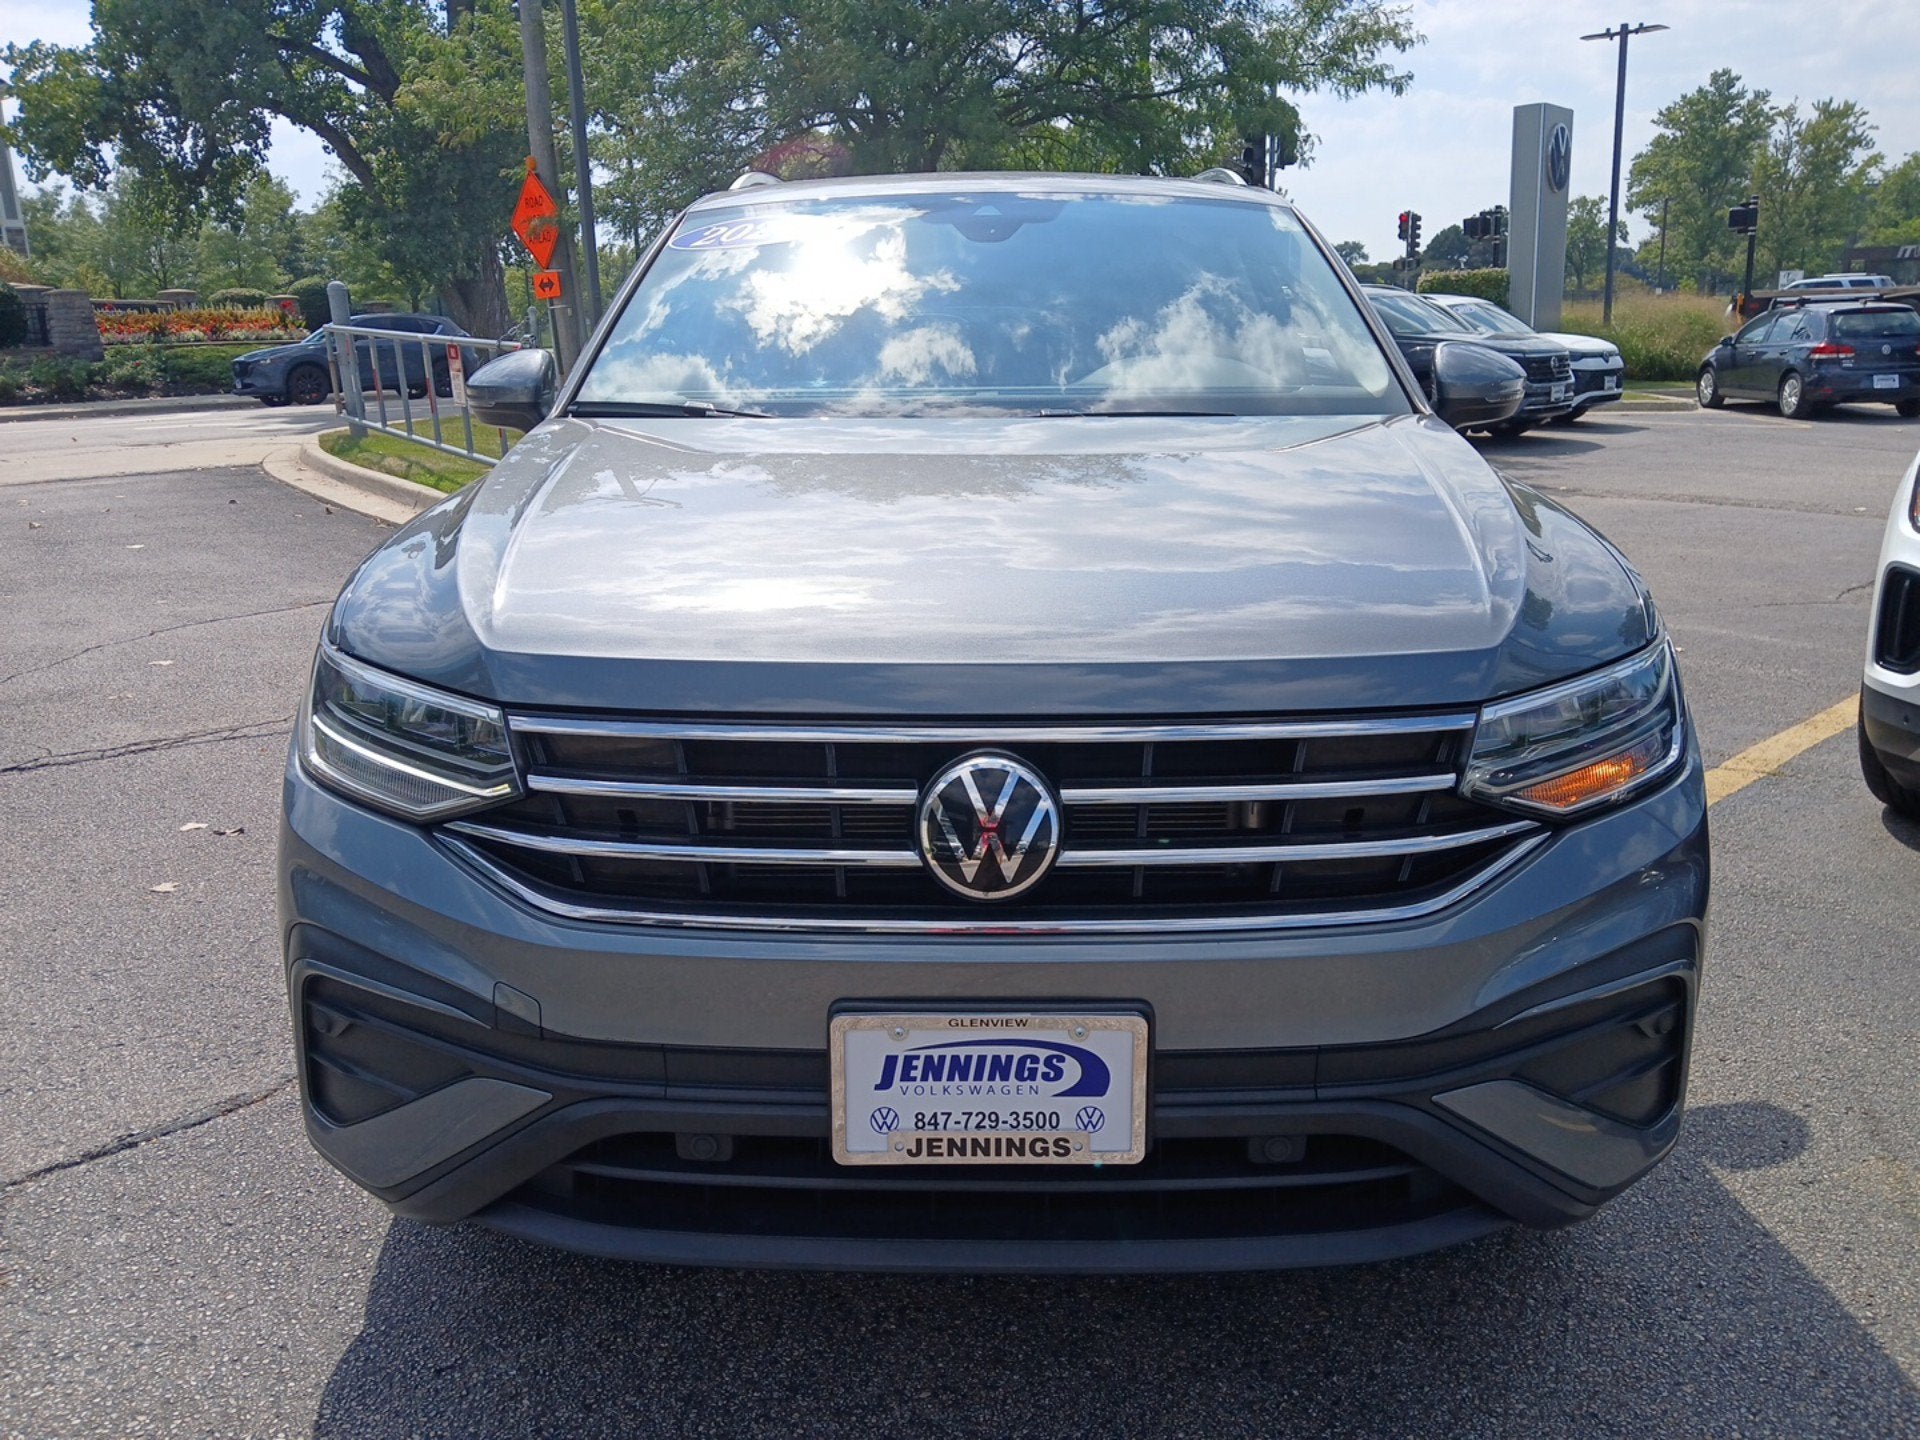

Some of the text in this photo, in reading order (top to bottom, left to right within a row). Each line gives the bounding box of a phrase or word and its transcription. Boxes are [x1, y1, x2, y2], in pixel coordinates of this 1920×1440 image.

[525, 195, 543, 208] ROAD
[948, 1018, 1029, 1028] GLENVIEW
[874, 1054, 1066, 1091] JENNINGS
[900, 1084, 1040, 1096] VOLKSWAGEN
[914, 1111, 1061, 1130] 847-729-3500
[906, 1137, 1072, 1157] JENNINGS
